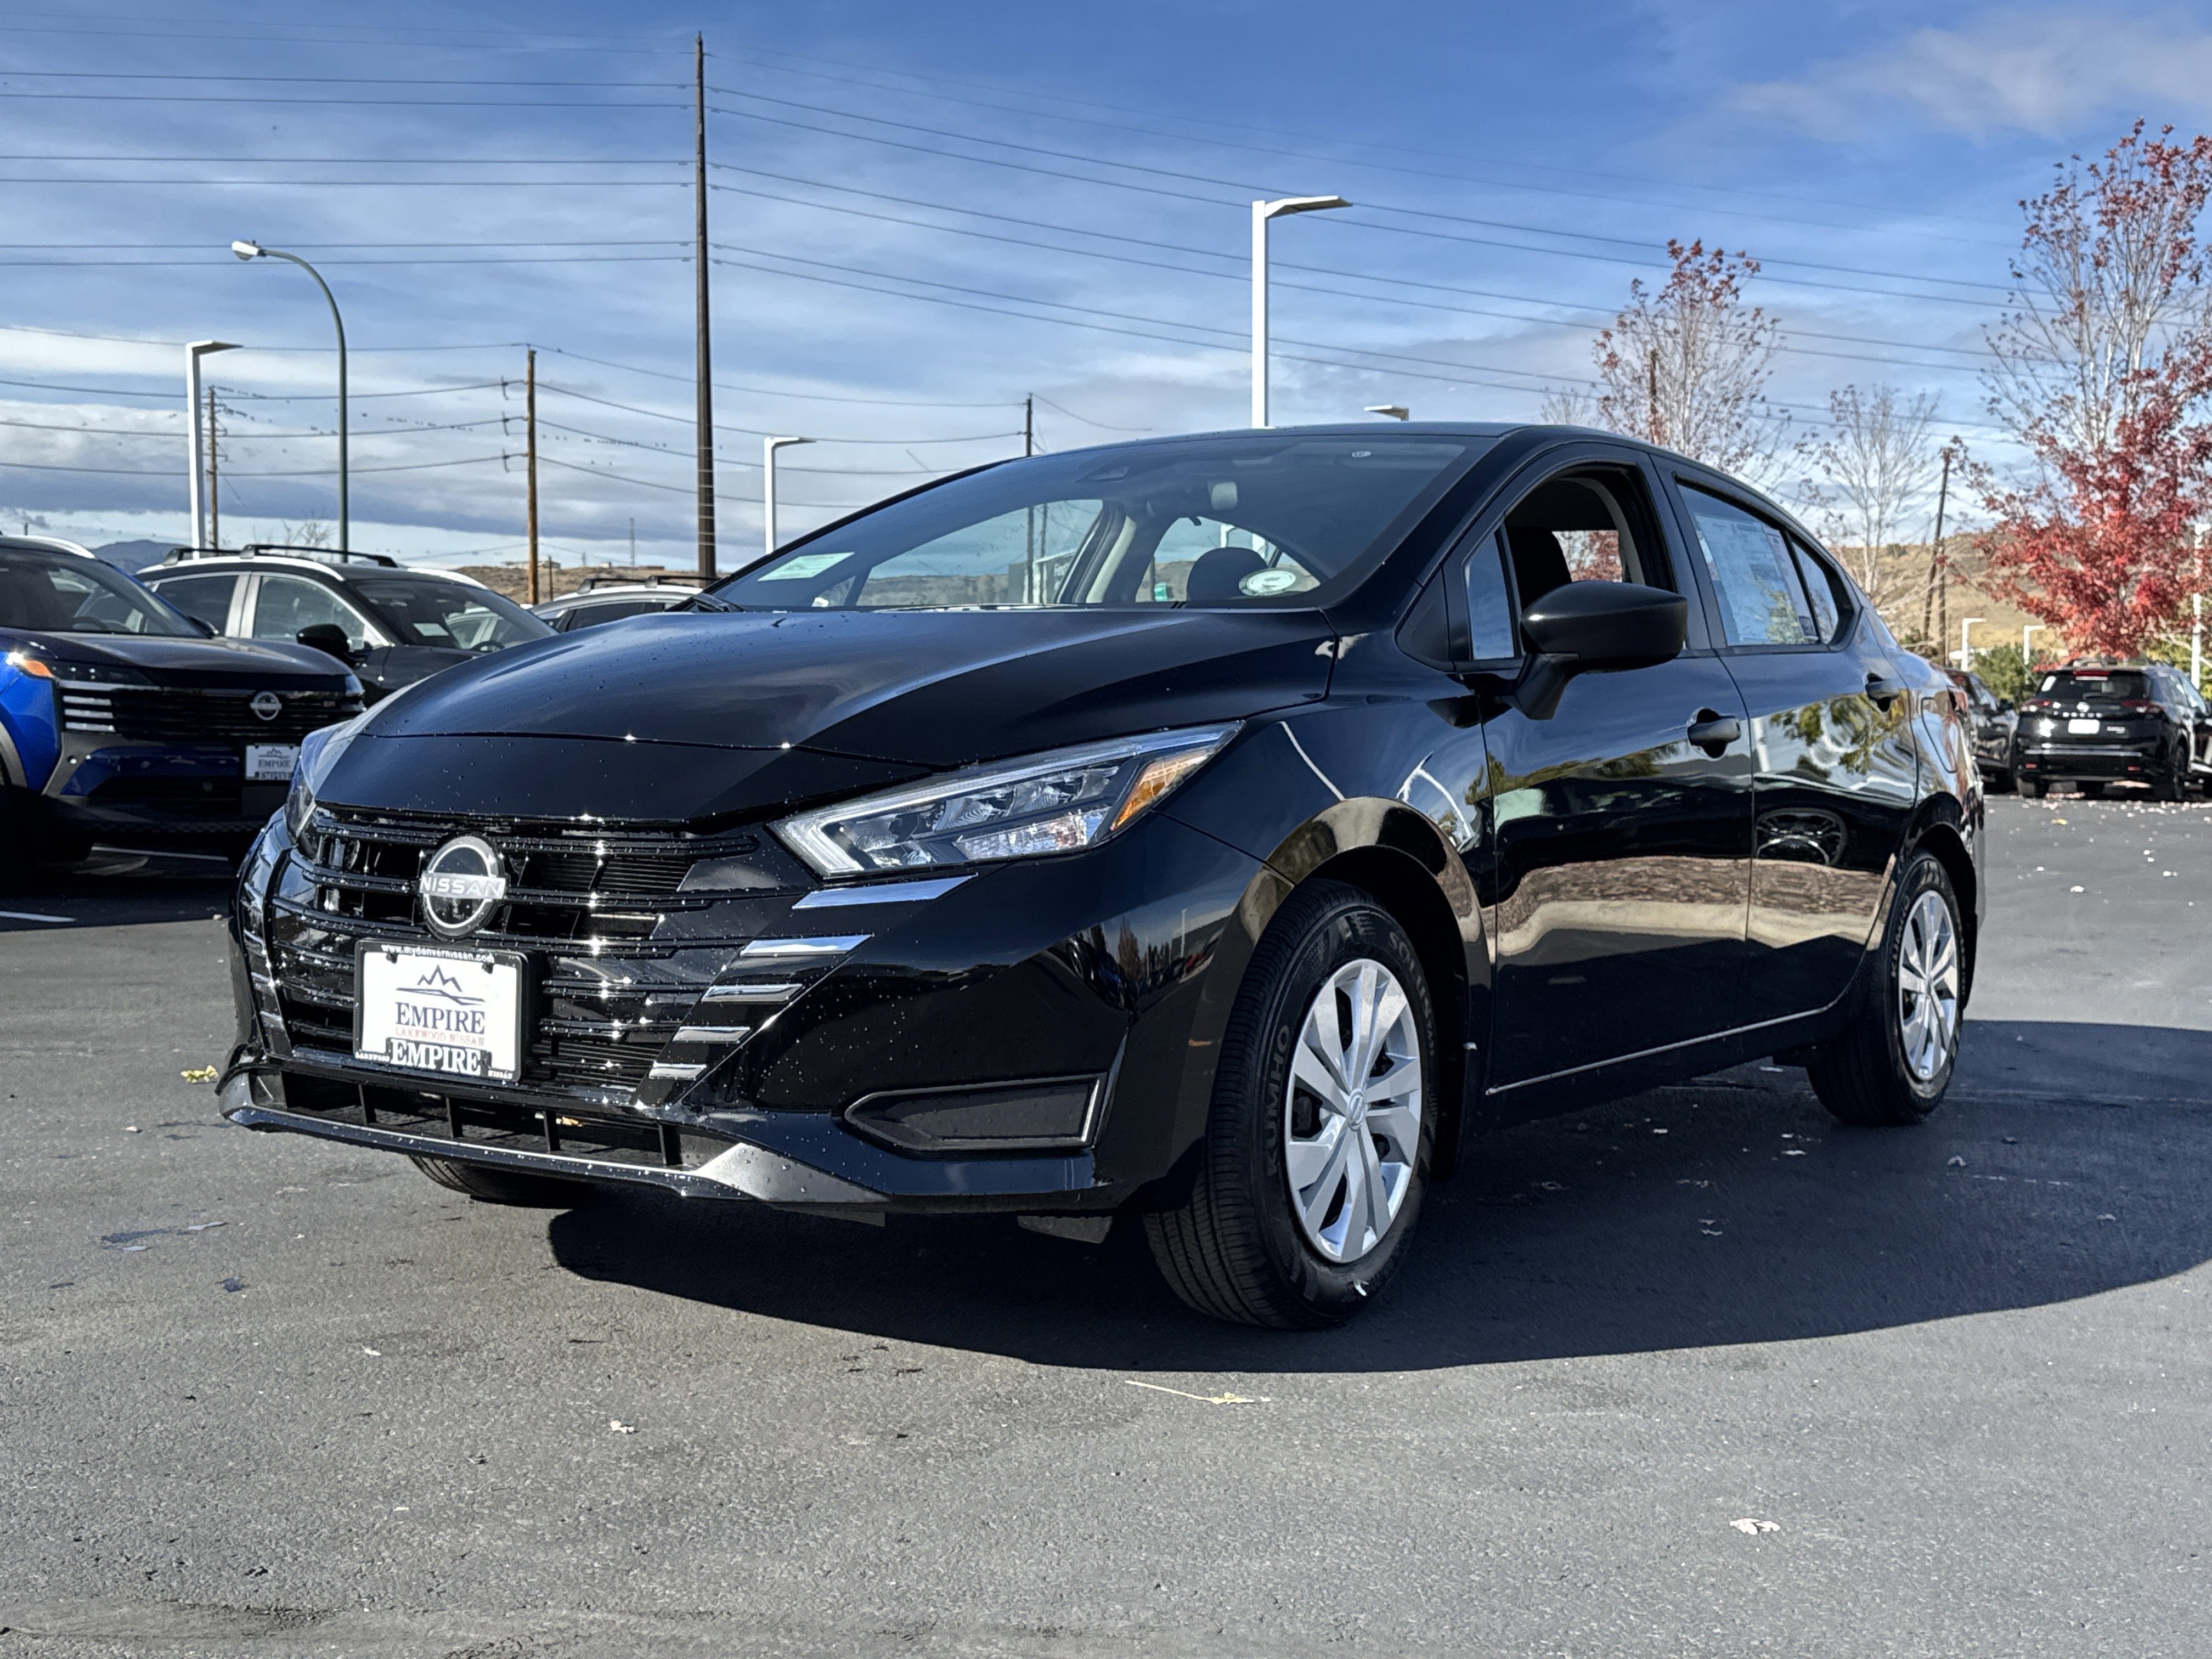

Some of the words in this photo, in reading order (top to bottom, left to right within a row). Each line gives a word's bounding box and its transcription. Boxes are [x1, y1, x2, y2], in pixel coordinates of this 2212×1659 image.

[258, 759, 291, 768] EMPIRE
[259, 771, 290, 780] EMPIRE
[420, 876, 504, 896] NISSAN
[381, 944, 495, 963] www.mydenvernissan.com
[396, 1002, 485, 1035] EMPIRE
[395, 1026, 446, 1042] LAKEWOOD
[449, 1034, 485, 1046] NISSAN
[390, 1038, 481, 1076] EMPIRE
[1263, 1025, 1289, 1176] KUMHO
